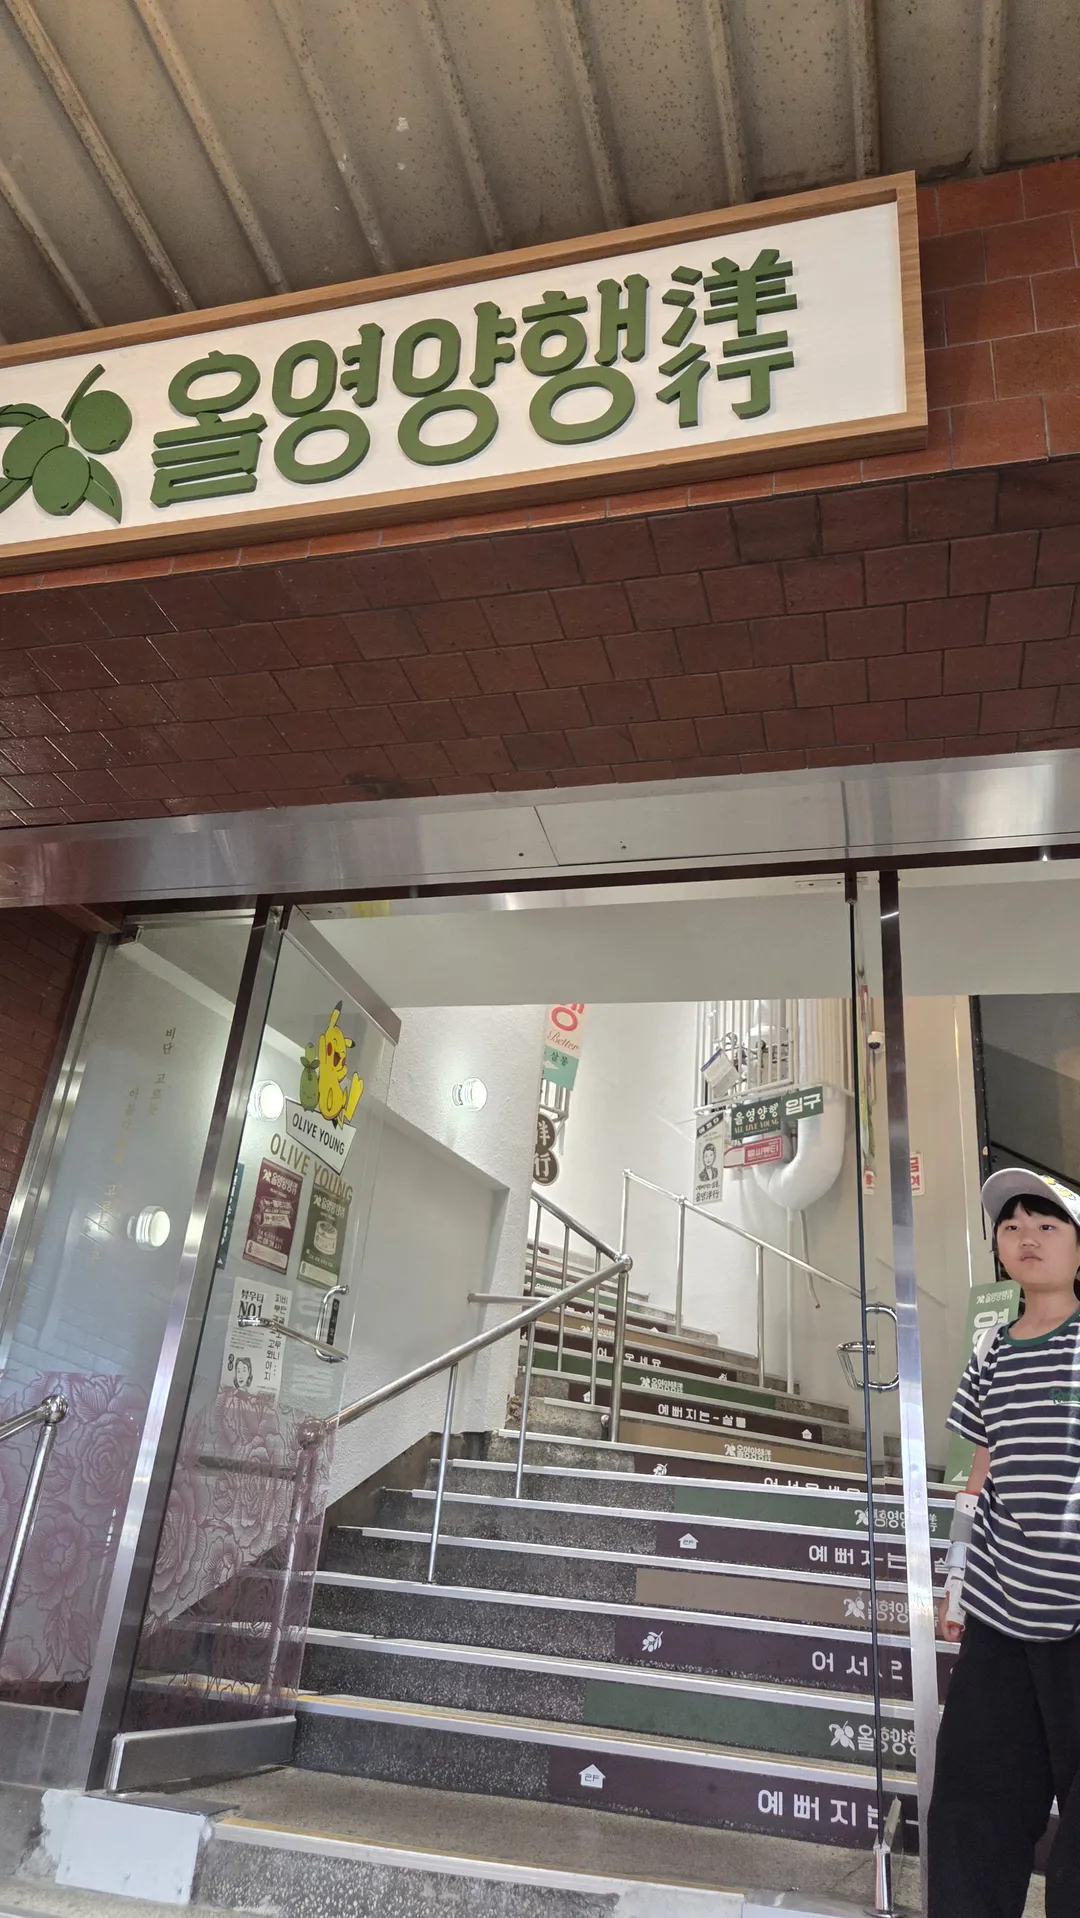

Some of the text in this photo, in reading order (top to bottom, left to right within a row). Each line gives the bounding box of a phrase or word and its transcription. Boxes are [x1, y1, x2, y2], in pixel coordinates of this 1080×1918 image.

[150, 273, 651, 507] 올영양행
[547, 1030, 579, 1051] Better
[733, 1102, 779, 1126] 올영양행
[785, 1093, 821, 1116] 입구
[292, 1112, 345, 1156] OLIVE YOUNG
[270, 1132, 354, 1201] OLIVE YOUNG
